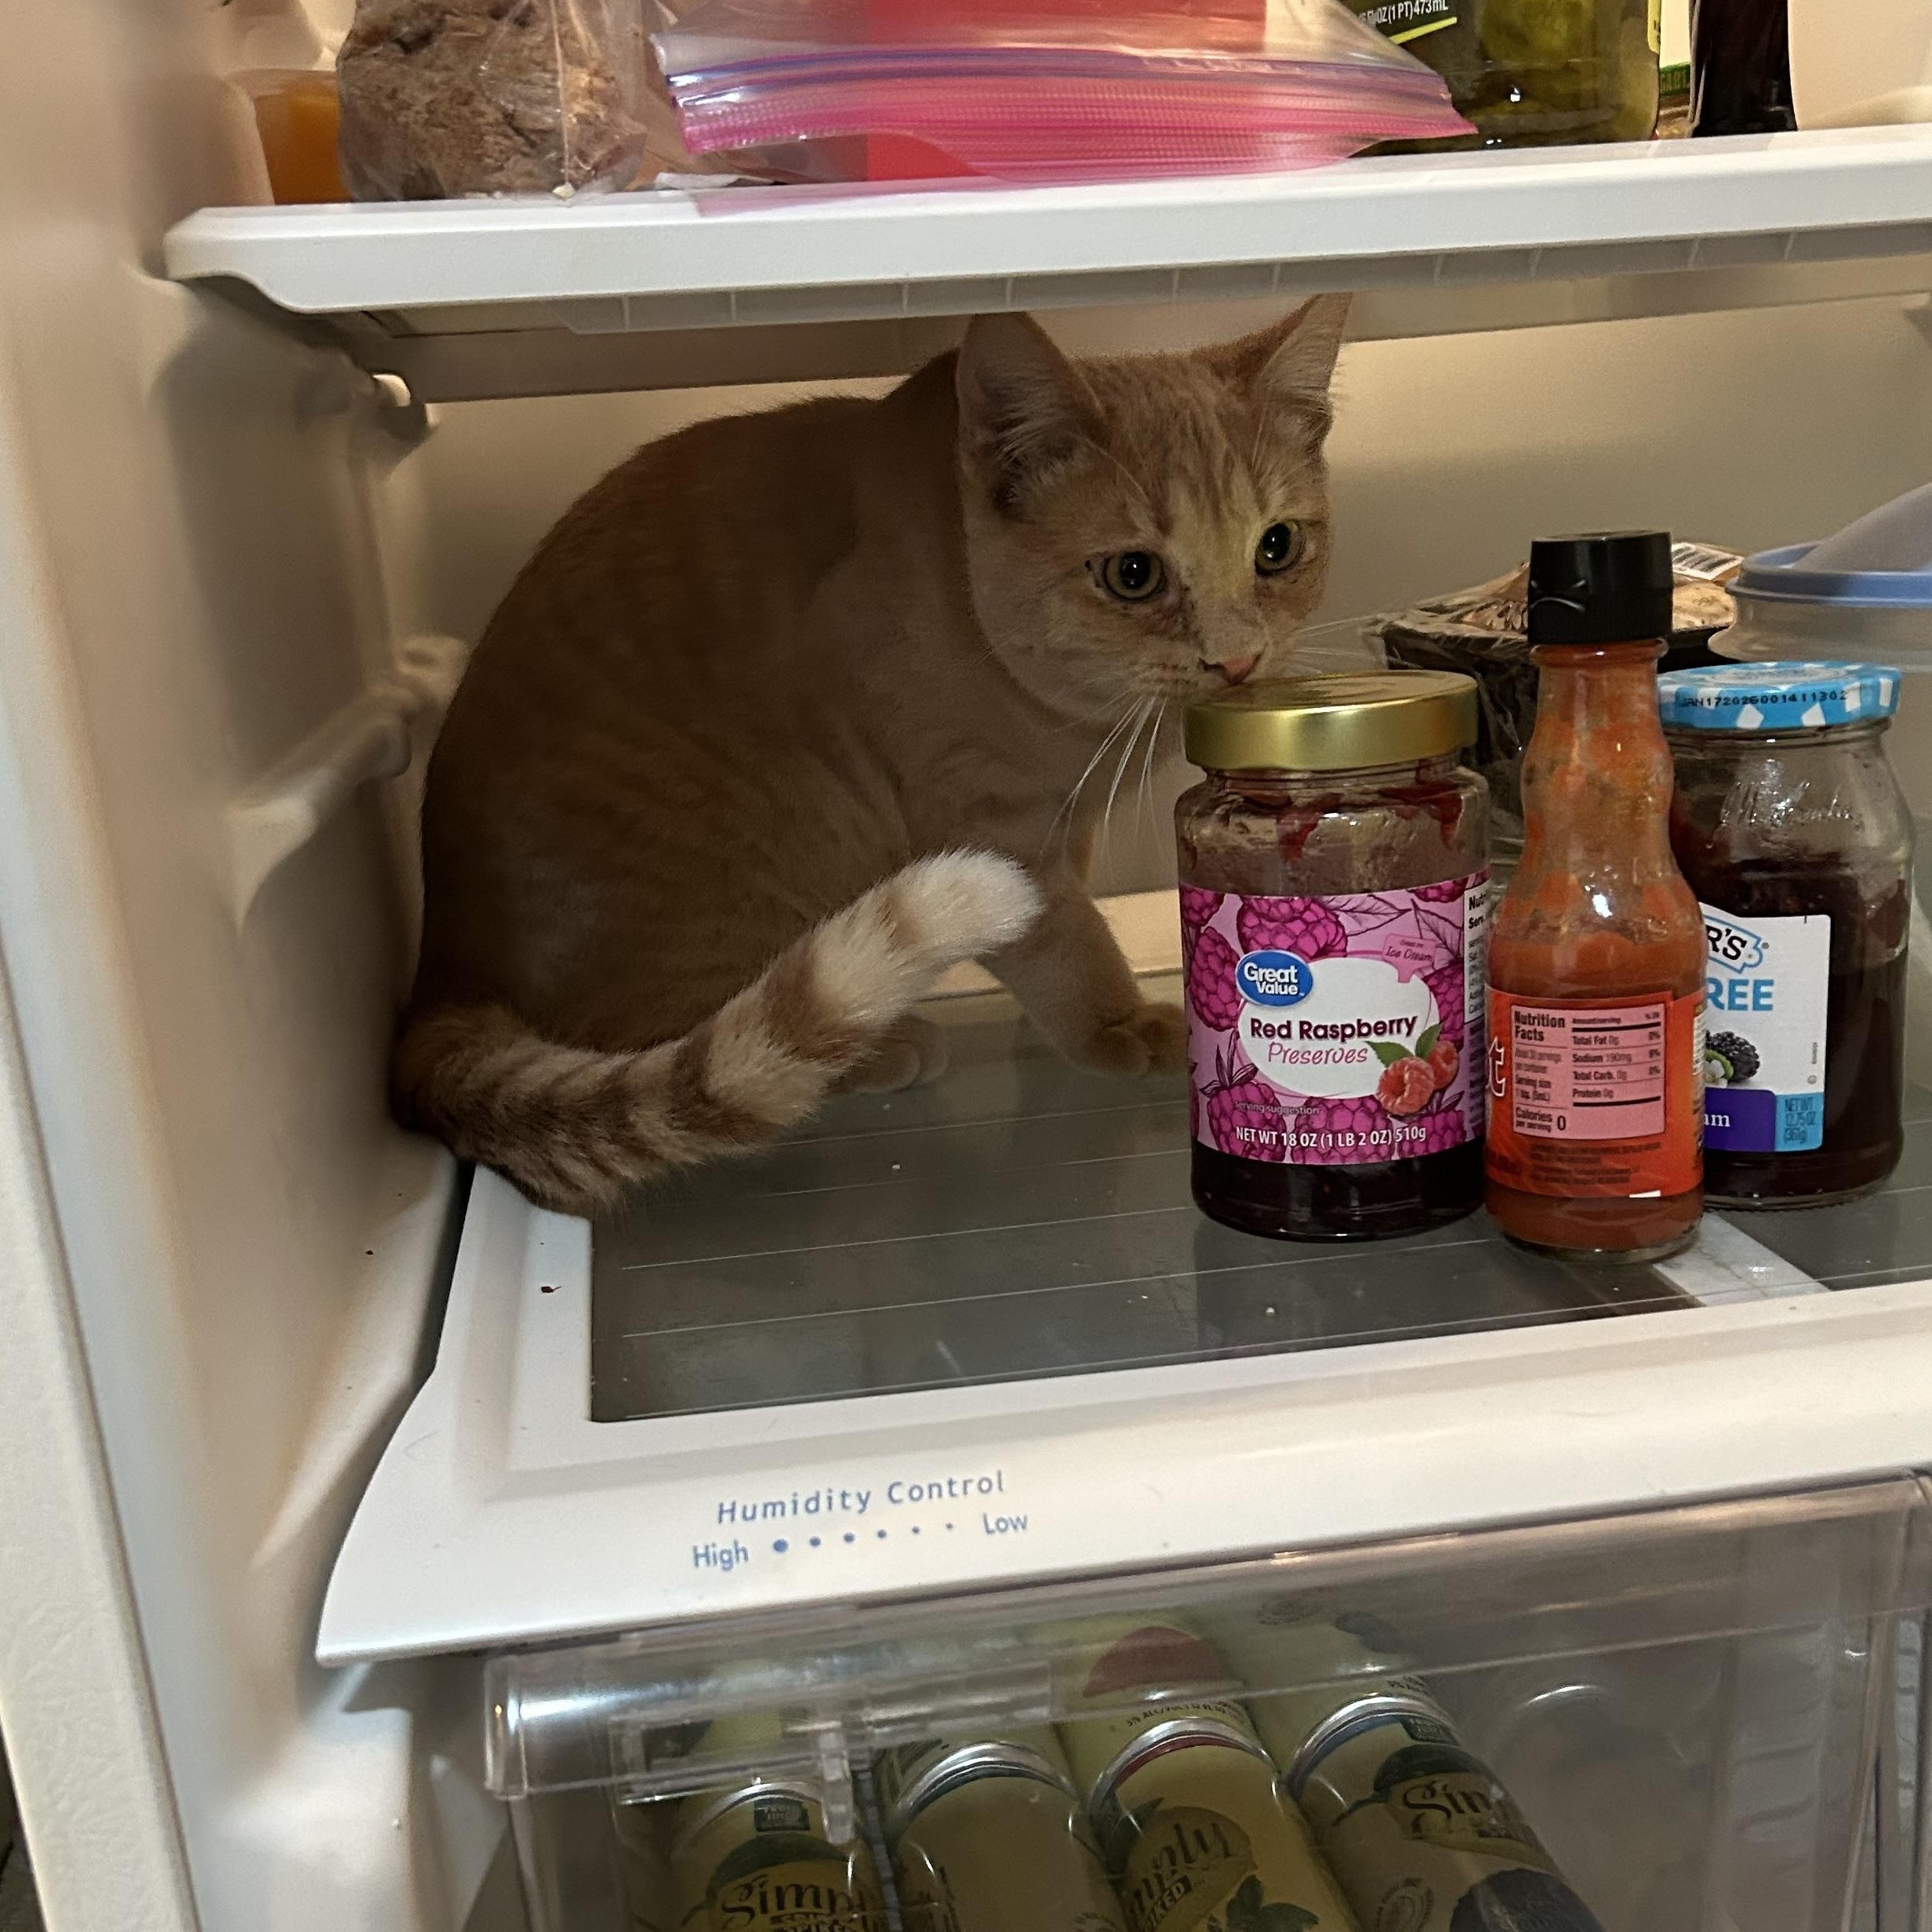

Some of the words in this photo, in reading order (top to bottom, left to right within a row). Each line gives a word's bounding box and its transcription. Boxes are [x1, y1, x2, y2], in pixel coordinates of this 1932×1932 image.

[1385, 946, 1402, 958] Ice
[1404, 948, 1433, 962] Cream
[1244, 962, 1298, 983] Great
[1255, 981, 1298, 995] Value
[1705, 977, 1774, 1011] REE
[1251, 1018, 1292, 1039] Red
[1298, 1016, 1418, 1043] Raspberry
[1514, 1011, 1566, 1028] Nutrition
[1514, 1026, 1545, 1041] Facts
[1267, 1040, 1369, 1065] Preserves
[1236, 1101, 1265, 1113] serving
[1266, 1105, 1320, 1117] suggestion
[1515, 1107, 1553, 1122] Calories
[1556, 1114, 1567, 1131] 0
[1236, 1126, 1257, 1142] NET
[1258, 1129, 1279, 1145] WT
[1280, 1132, 1298, 1146] 18
[1299, 1133, 1318, 1147] OZ
[1320, 1133, 1334, 1149] (1
[1337, 1132, 1356, 1147] LB
[1358, 1132, 1367, 1146] 2
[1370, 1129, 1393, 1146] OZ)
[1395, 1126, 1426, 1142] 510g
[717, 1488, 872, 1524] Humidity
[887, 1469, 1004, 1505] Control
[982, 1512, 1030, 1534] Low
[692, 1539, 750, 1571] High
